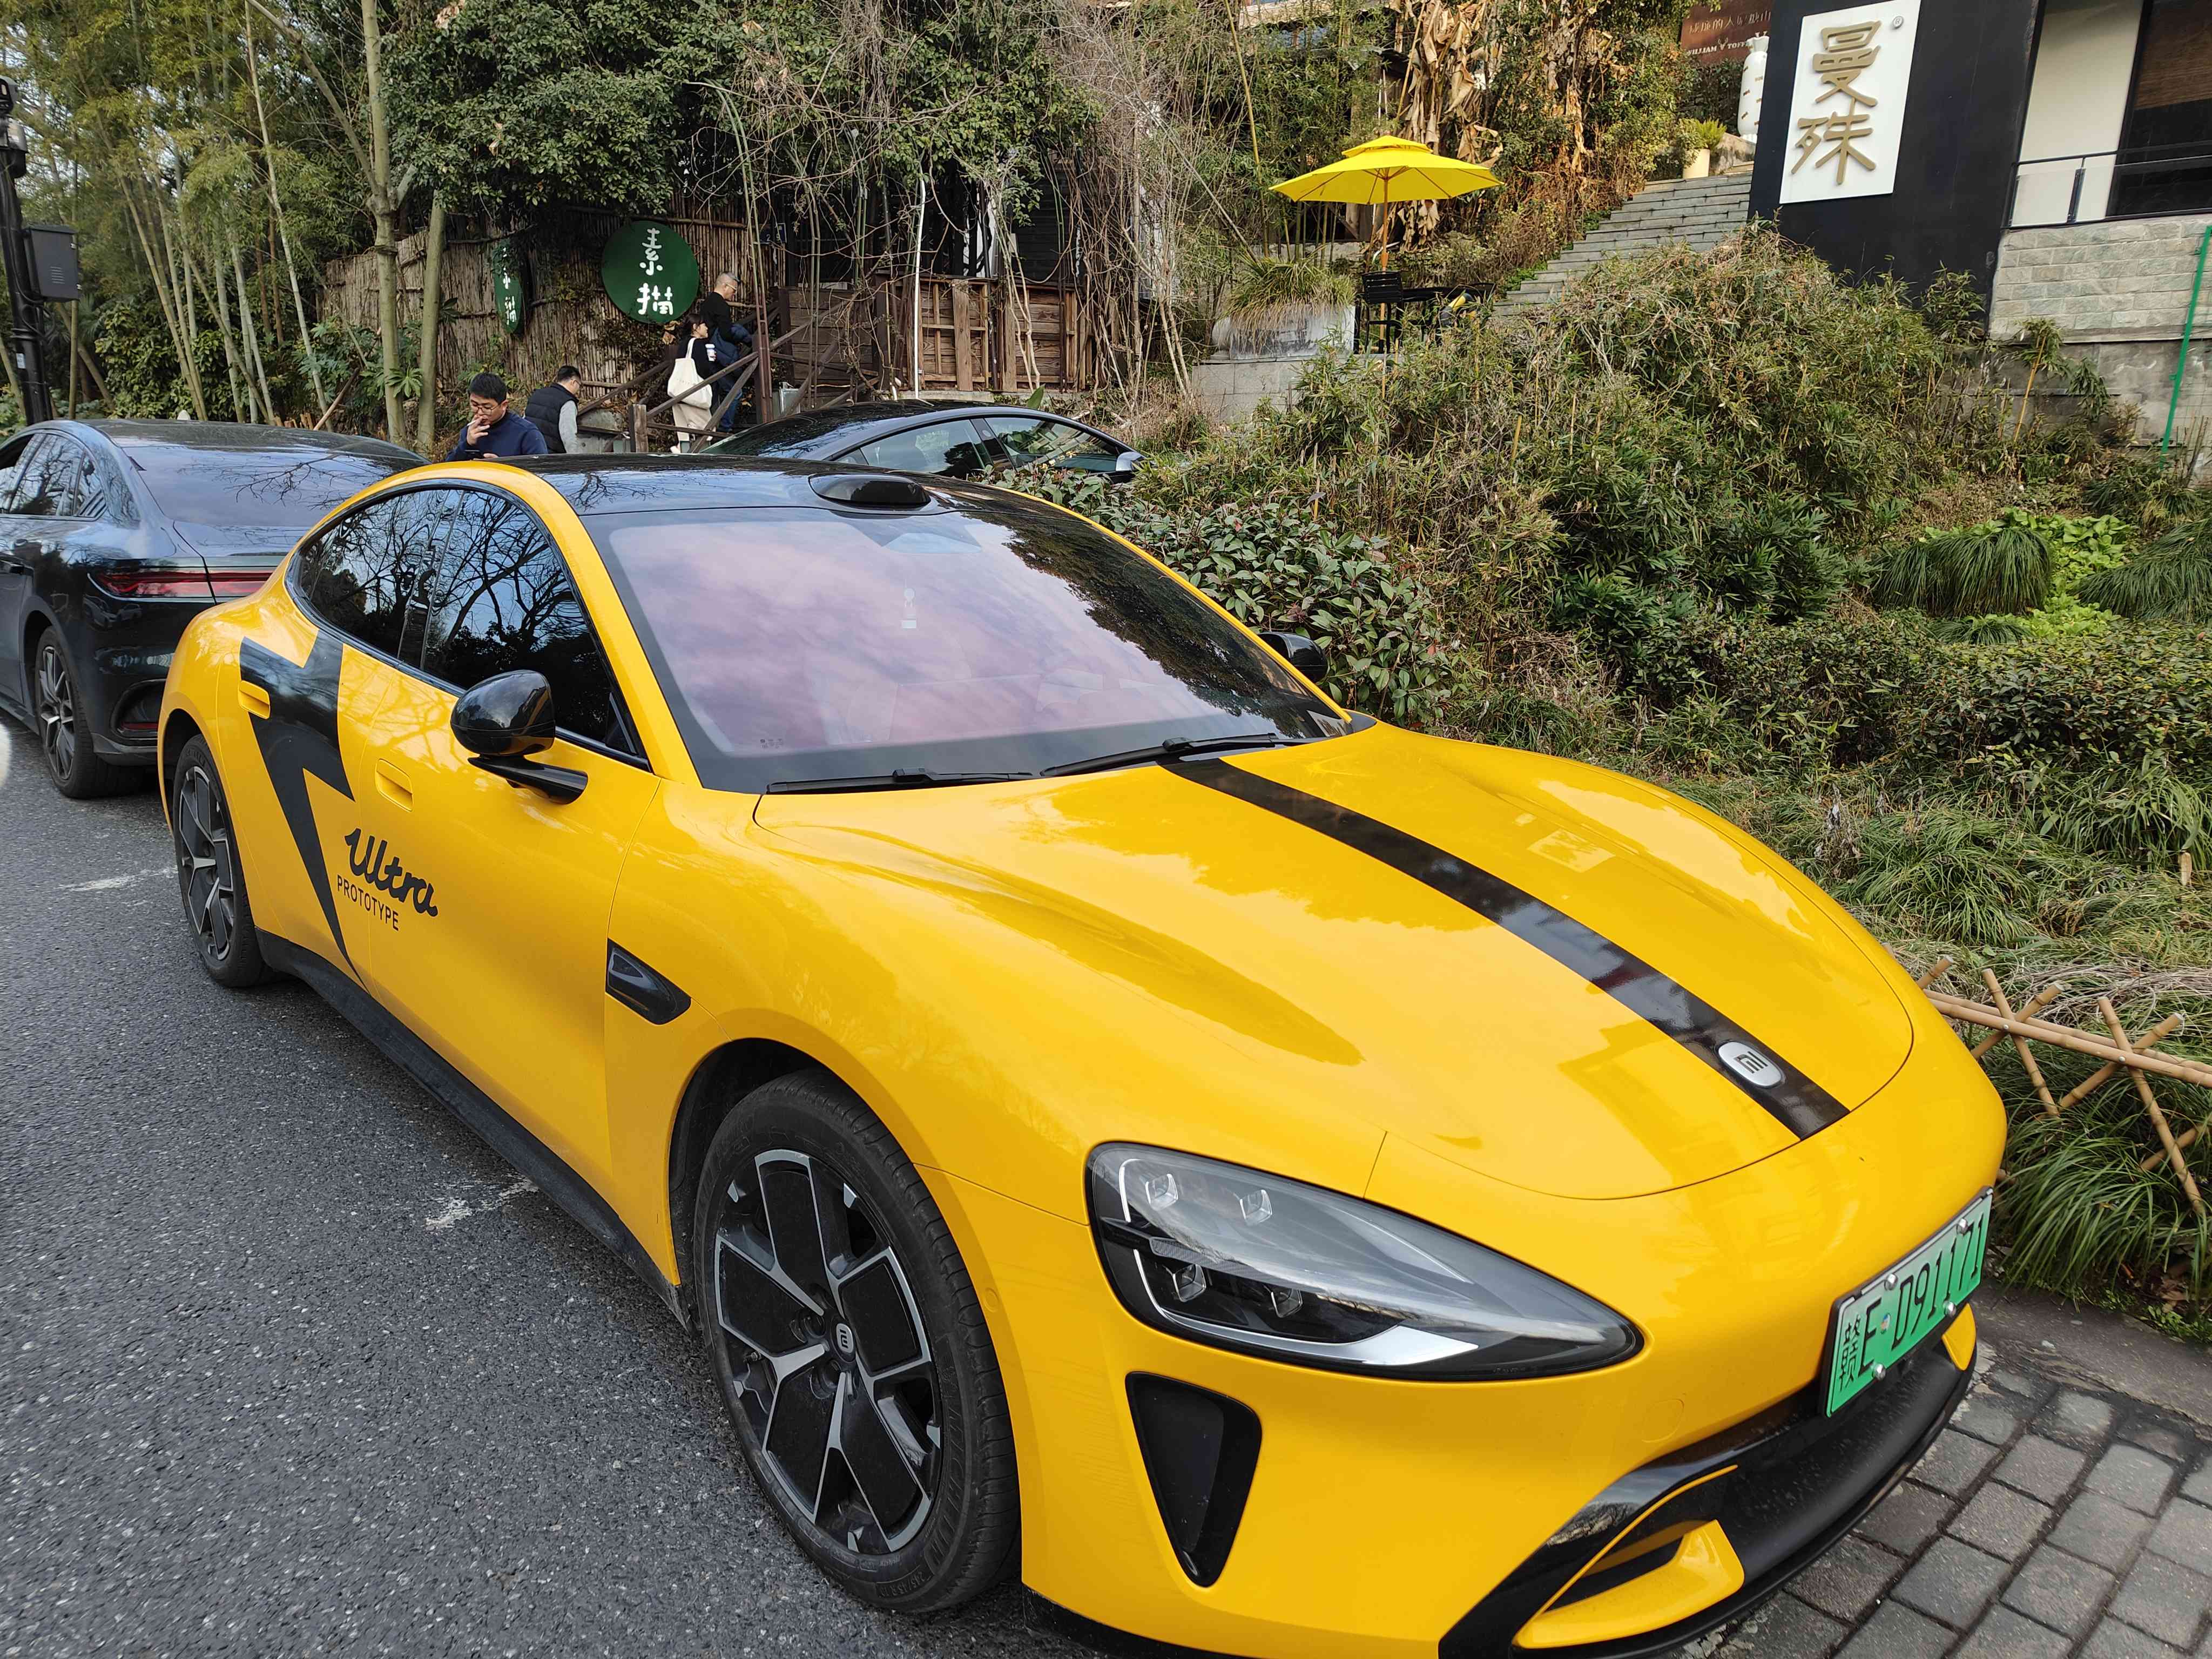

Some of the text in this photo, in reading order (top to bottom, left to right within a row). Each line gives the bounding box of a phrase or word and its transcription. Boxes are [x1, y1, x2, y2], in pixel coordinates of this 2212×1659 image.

[1791, 20, 1882, 185] 曼殊
[637, 227, 673, 315] 素描
[337, 874, 399, 932] PROTOTYPE
[344, 828, 438, 917] Ultra
